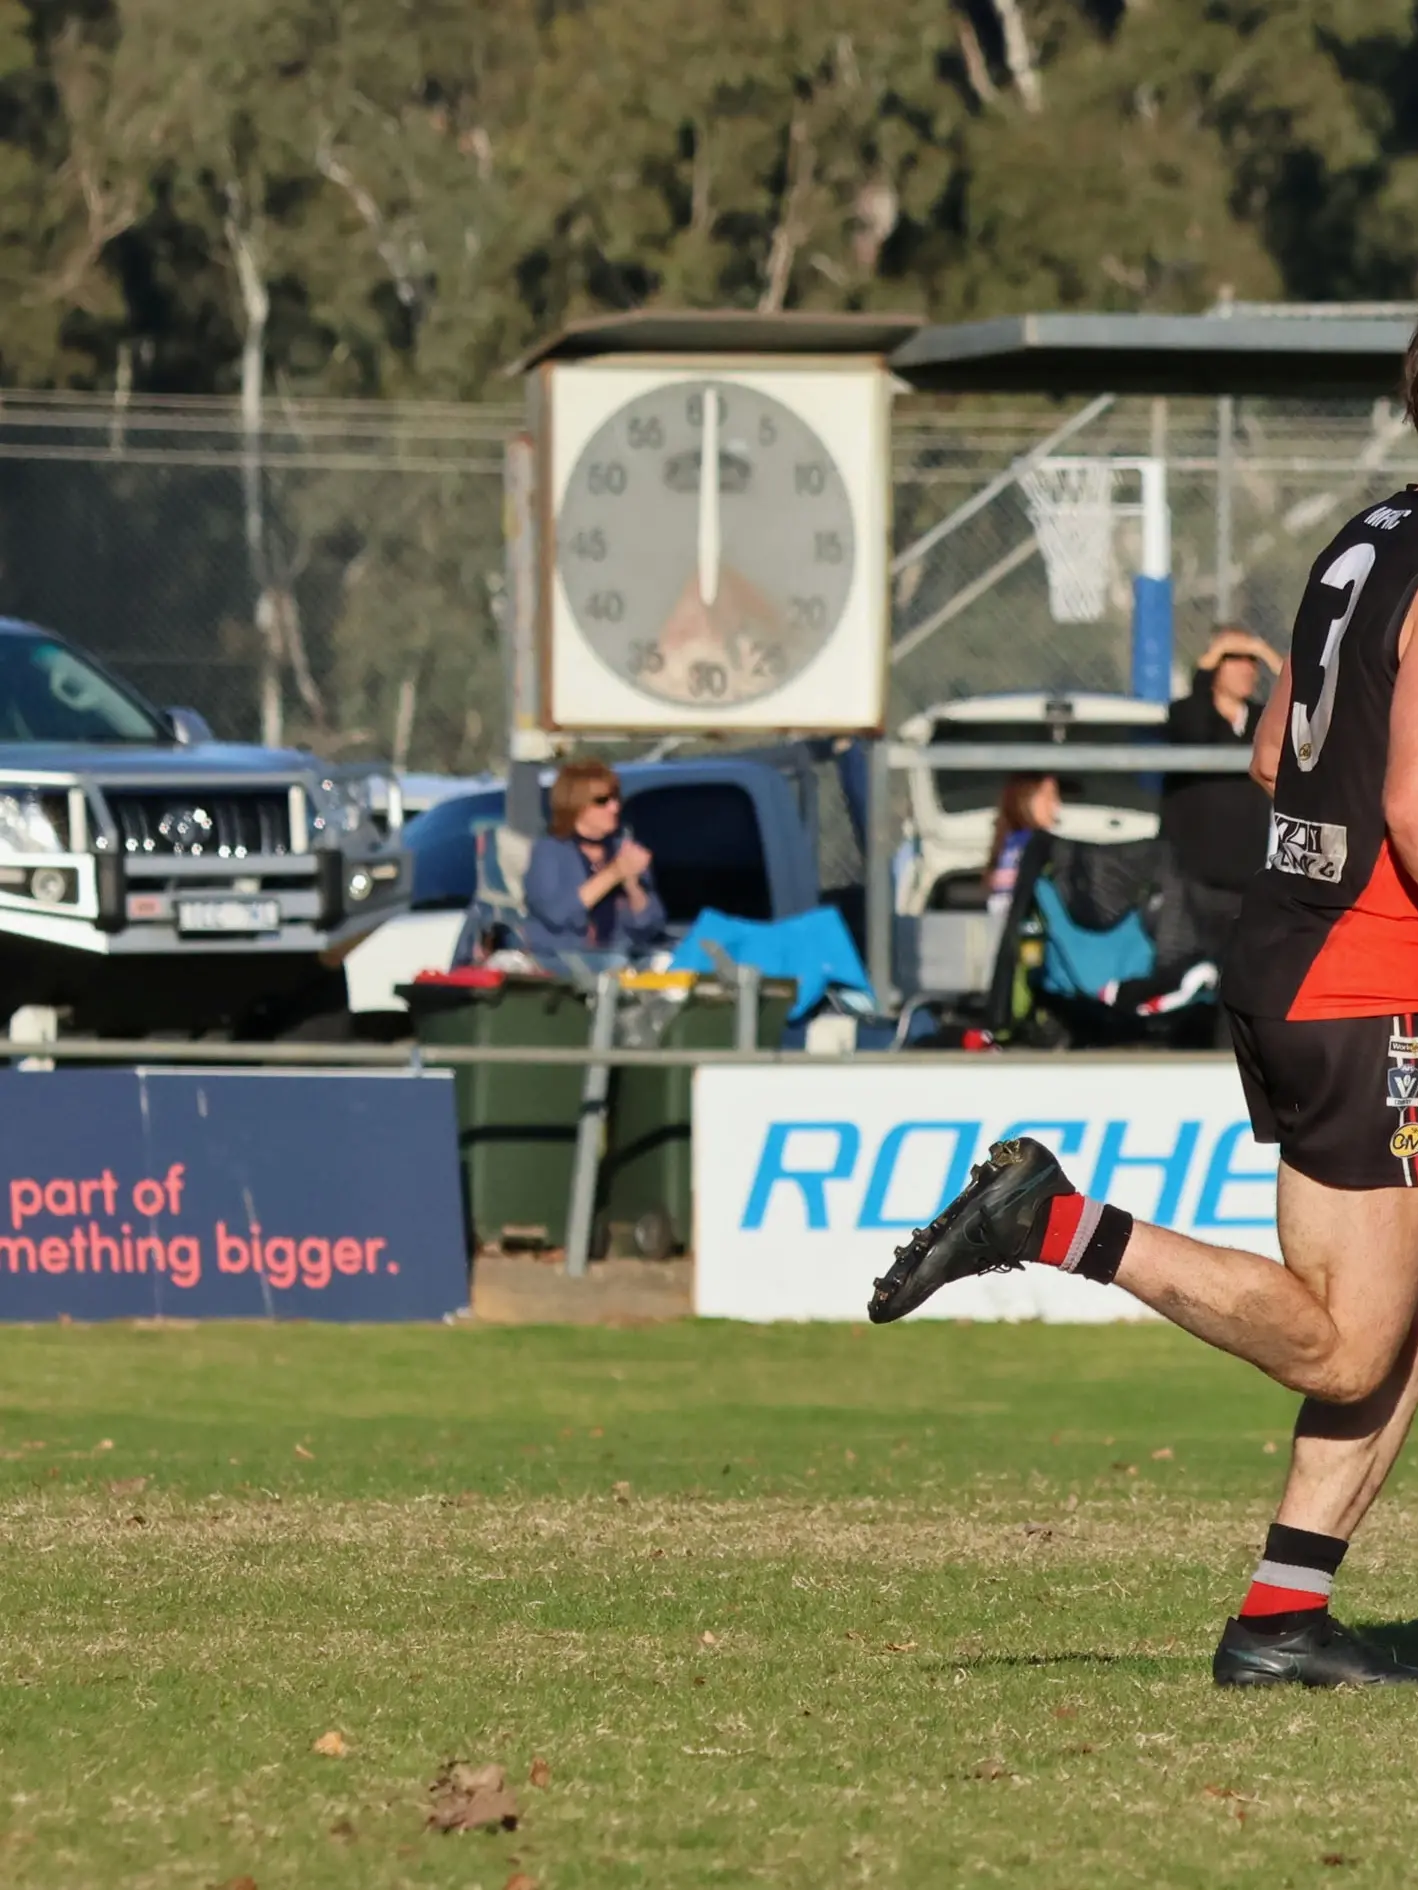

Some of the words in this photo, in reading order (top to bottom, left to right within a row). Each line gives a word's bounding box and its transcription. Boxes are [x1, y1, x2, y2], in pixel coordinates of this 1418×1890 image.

[627, 416, 667, 450] 55
[758, 415, 779, 448] 5
[587, 461, 628, 496] 50
[794, 462, 826, 496] 10
[569, 527, 608, 563] 45
[813, 530, 844, 565] 15
[584, 588, 626, 623] 40
[1292, 542, 1376, 772] 3
[686, 659, 728, 698] 30
[10, 1168, 119, 1231] part
[131, 1162, 186, 1217] of
[215, 1219, 401, 1289] bigger.
